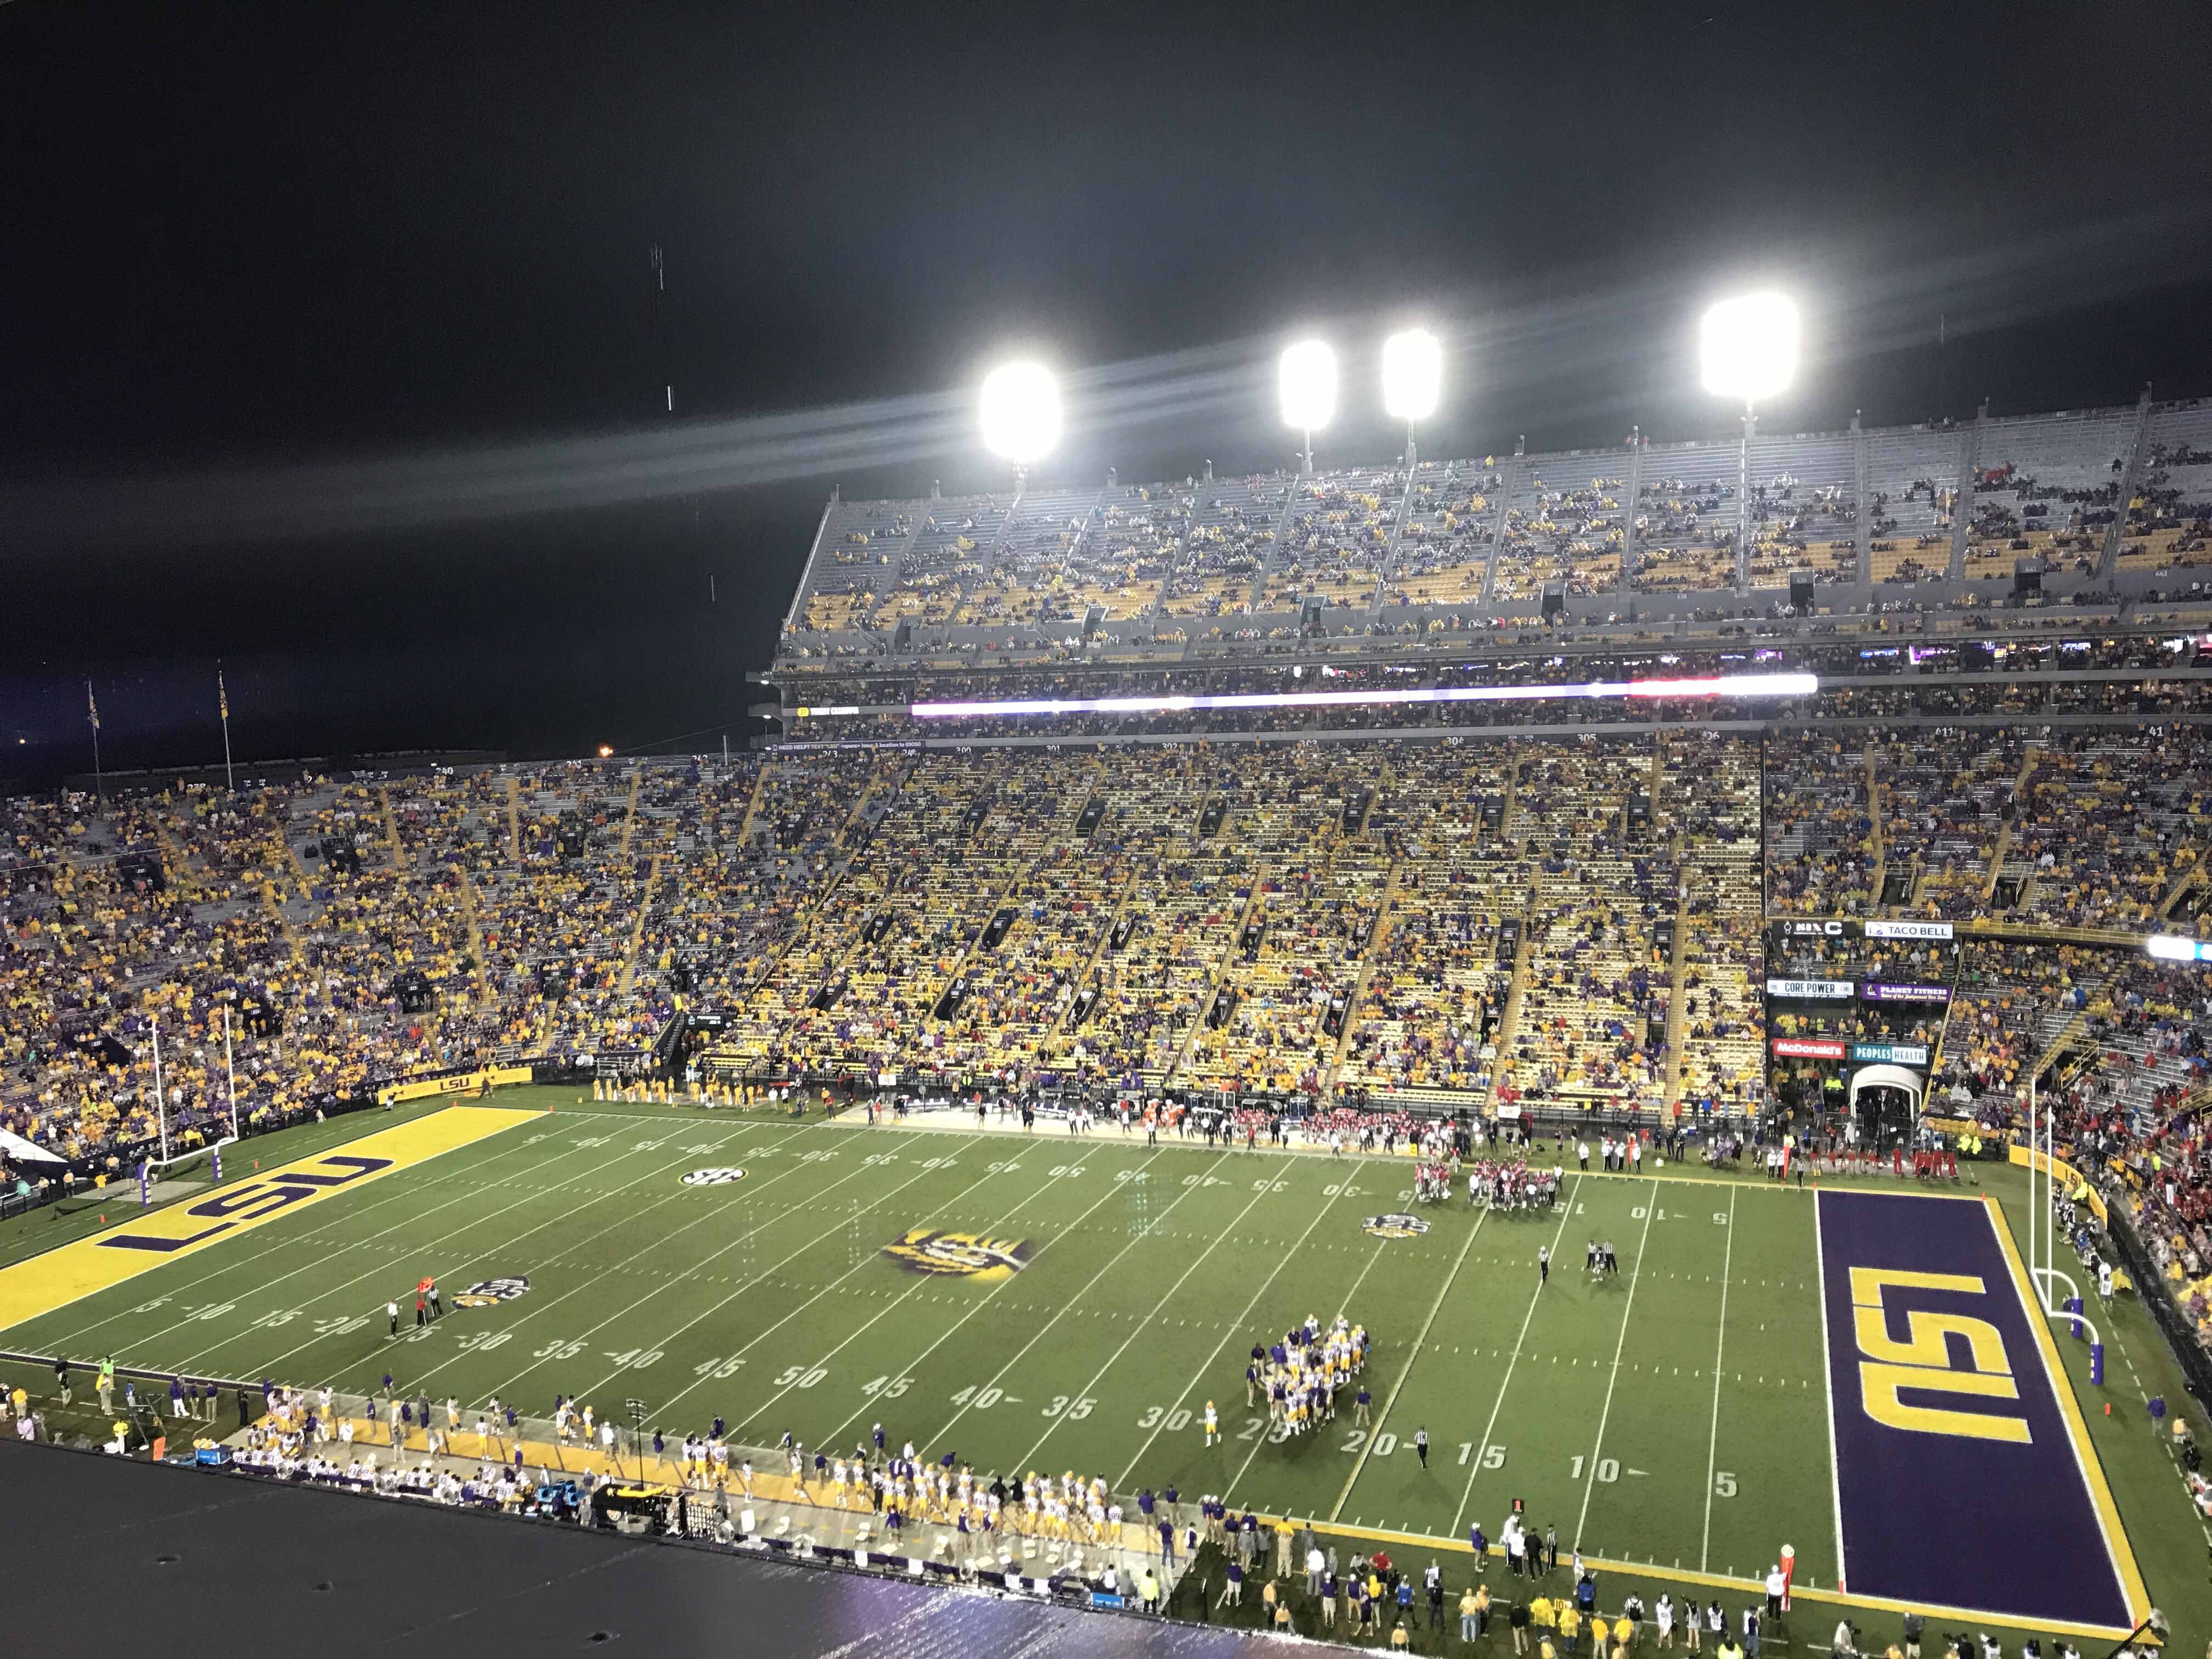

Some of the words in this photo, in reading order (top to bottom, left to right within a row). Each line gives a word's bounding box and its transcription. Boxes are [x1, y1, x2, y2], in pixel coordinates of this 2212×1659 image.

[1888, 926, 1917, 935] TACO
[1920, 927, 1948, 936] BELL
[1785, 982, 1804, 992] CORE
[1807, 983, 1835, 994] POWER
[1778, 1042, 1842, 1055] McDonald's
[1857, 1047, 1892, 1059] PEOPLES
[1894, 1049, 1924, 1061] HEALTH
[440, 1077, 470, 1091] LSU
[94, 1155, 396, 1252] LSU
[136, 1297, 173, 1312] 5
[185, 1303, 236, 1319] 10
[251, 1310, 303, 1327] 15
[314, 1317, 370, 1335] 20
[459, 1332, 513, 1350] 30
[533, 1340, 588, 1359] 35
[613, 1348, 664, 1368] 40
[1848, 1267, 2033, 1443] LSU
[693, 1358, 746, 1378] 45
[774, 1367, 828, 1388] 50
[861, 1376, 915, 1397] 45
[950, 1386, 1003, 1408] 40
[1042, 1396, 1098, 1420] 35
[1137, 1407, 1193, 1431] 30
[1340, 1431, 1397, 1455] 20
[1458, 1443, 1507, 1469] 15
[1571, 1455, 1620, 1482] 10
[1716, 1472, 1737, 1497] 5
